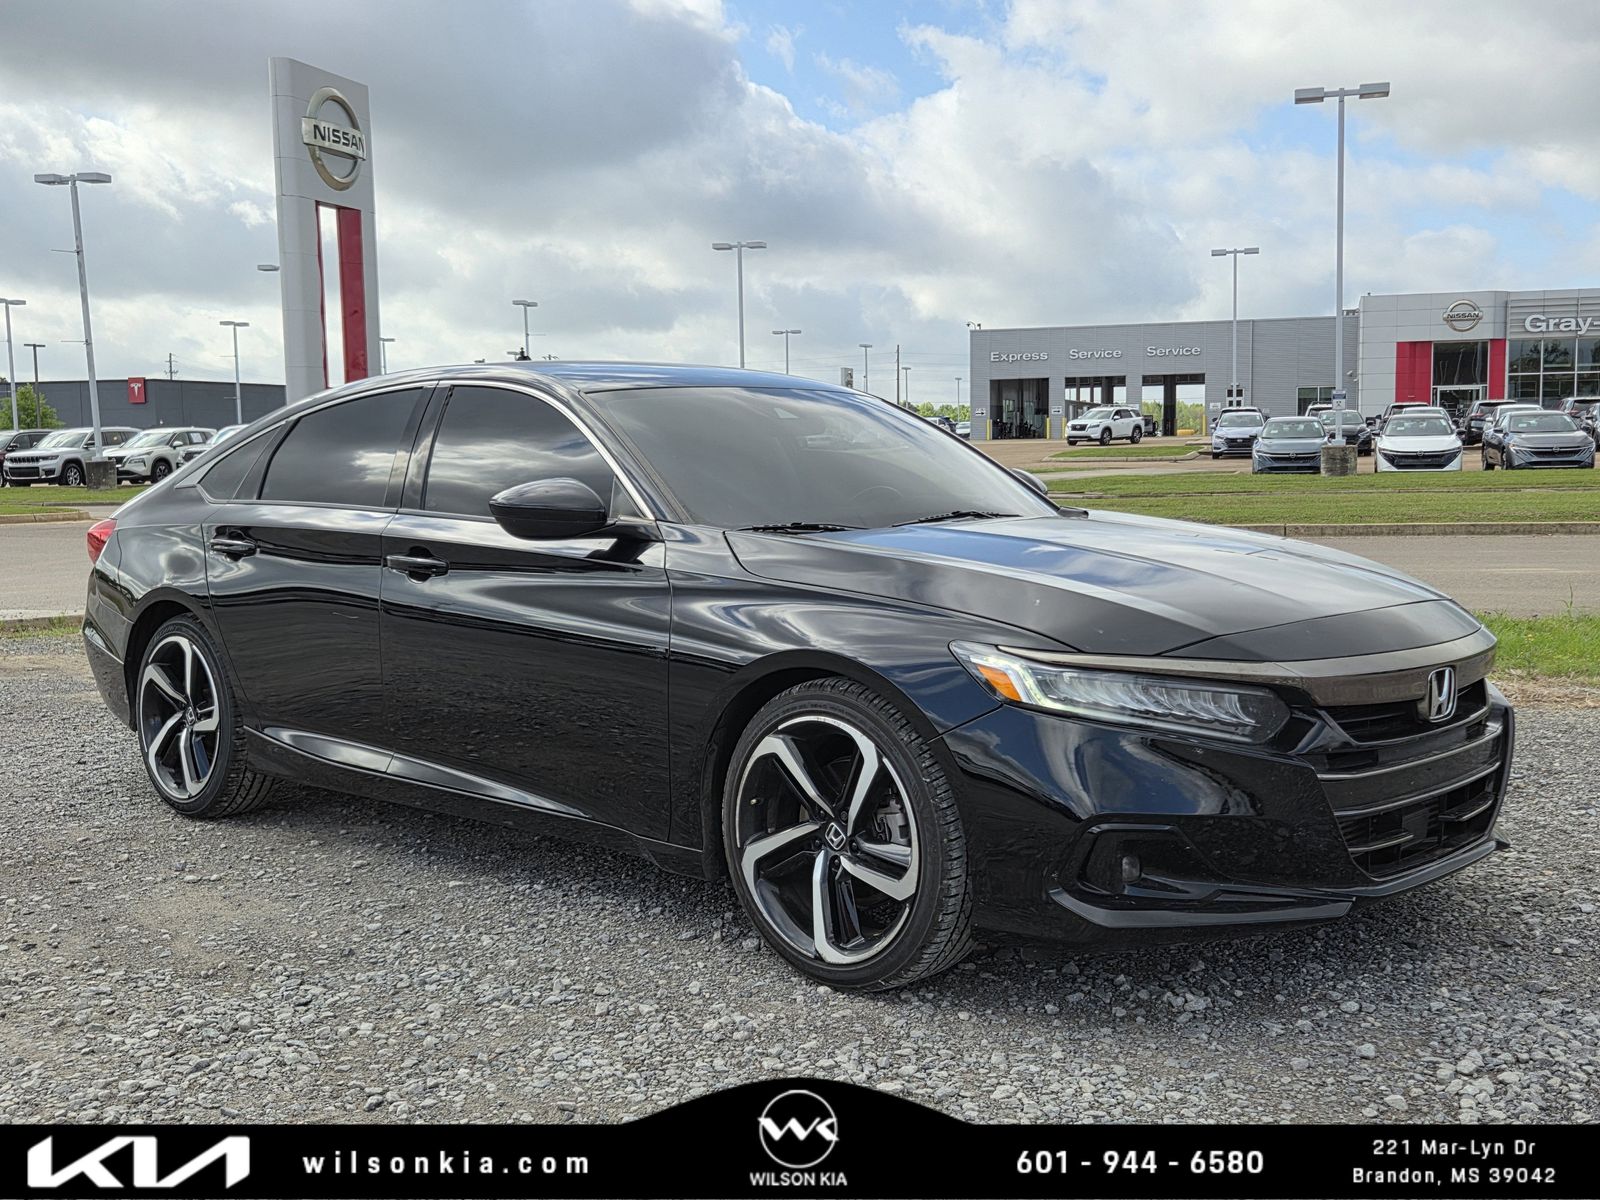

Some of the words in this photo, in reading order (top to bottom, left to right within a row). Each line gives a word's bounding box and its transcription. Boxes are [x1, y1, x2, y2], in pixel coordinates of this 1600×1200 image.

[313, 123, 365, 154] NISSAN
[990, 351, 1049, 363] Express
[1069, 348, 1122, 360] Service
[1146, 345, 1201, 357] Service
